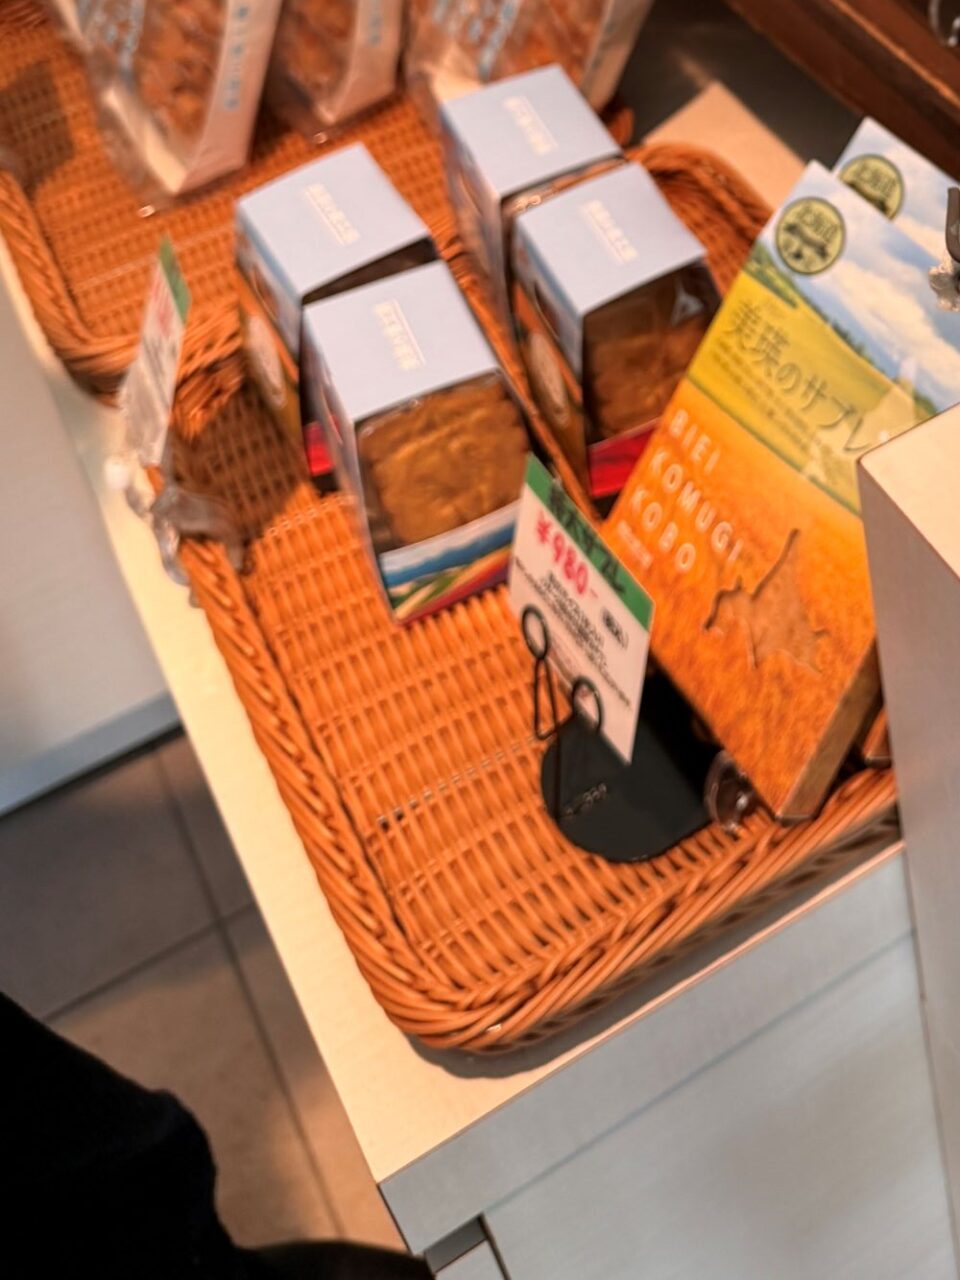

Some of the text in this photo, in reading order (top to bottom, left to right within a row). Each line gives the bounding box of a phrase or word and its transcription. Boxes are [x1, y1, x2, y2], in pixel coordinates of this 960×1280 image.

[668, 408, 722, 475] BIEI
[630, 486, 697, 572] KOBO
[648, 448, 746, 565] KOMUGI
